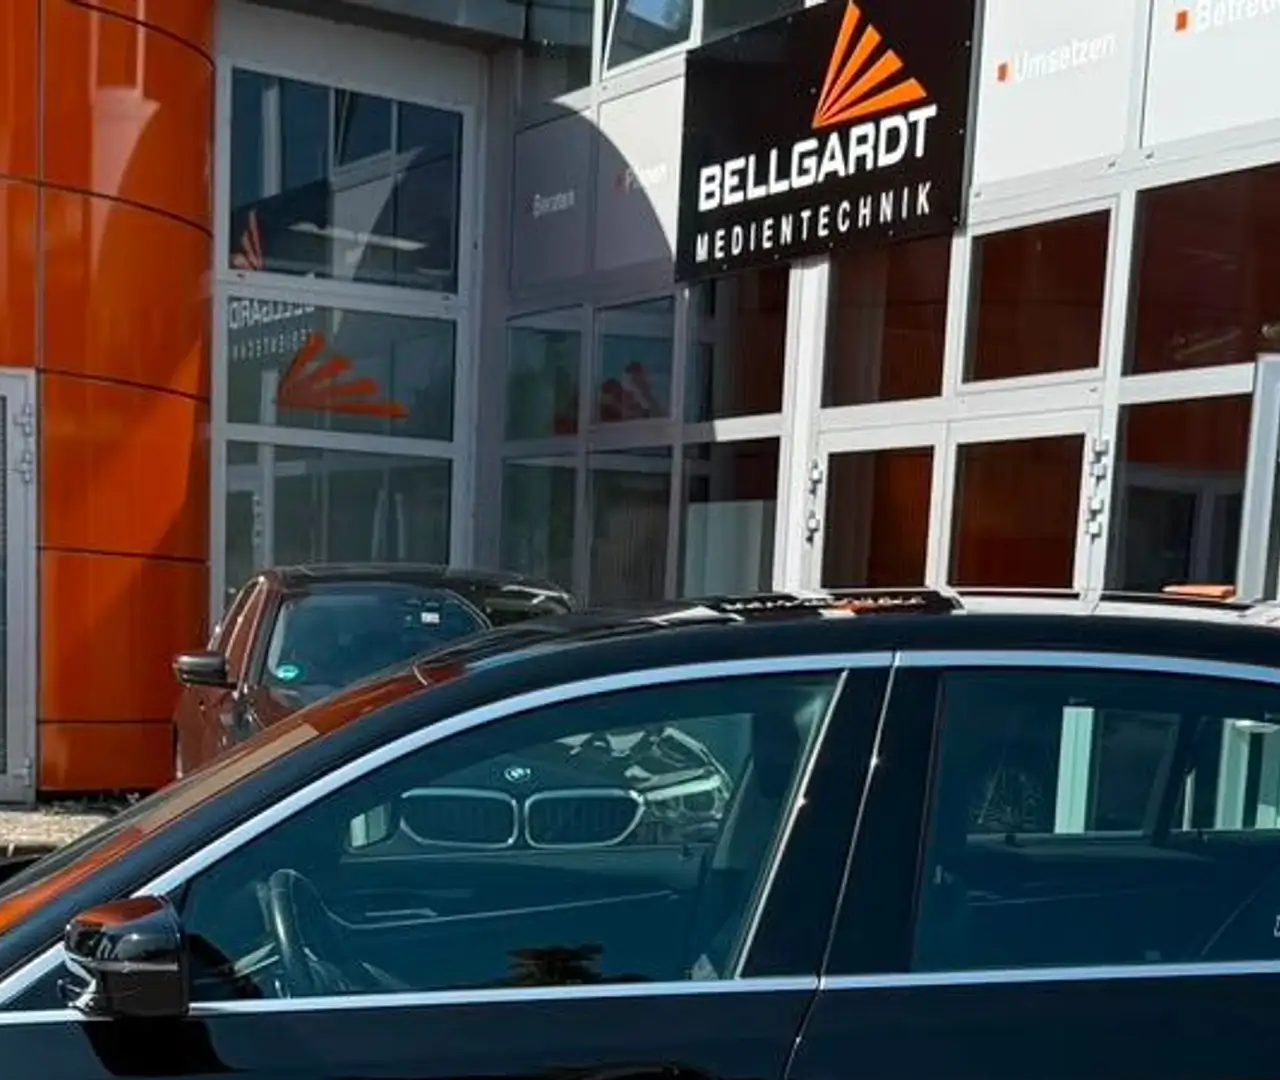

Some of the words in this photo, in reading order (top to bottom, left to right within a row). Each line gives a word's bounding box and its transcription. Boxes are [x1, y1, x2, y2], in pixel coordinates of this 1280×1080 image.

[1014, 31, 1118, 83] Umsetzen
[698, 104, 938, 213] BELLGARDT
[695, 182, 933, 263] MEDIENTECHNIK
